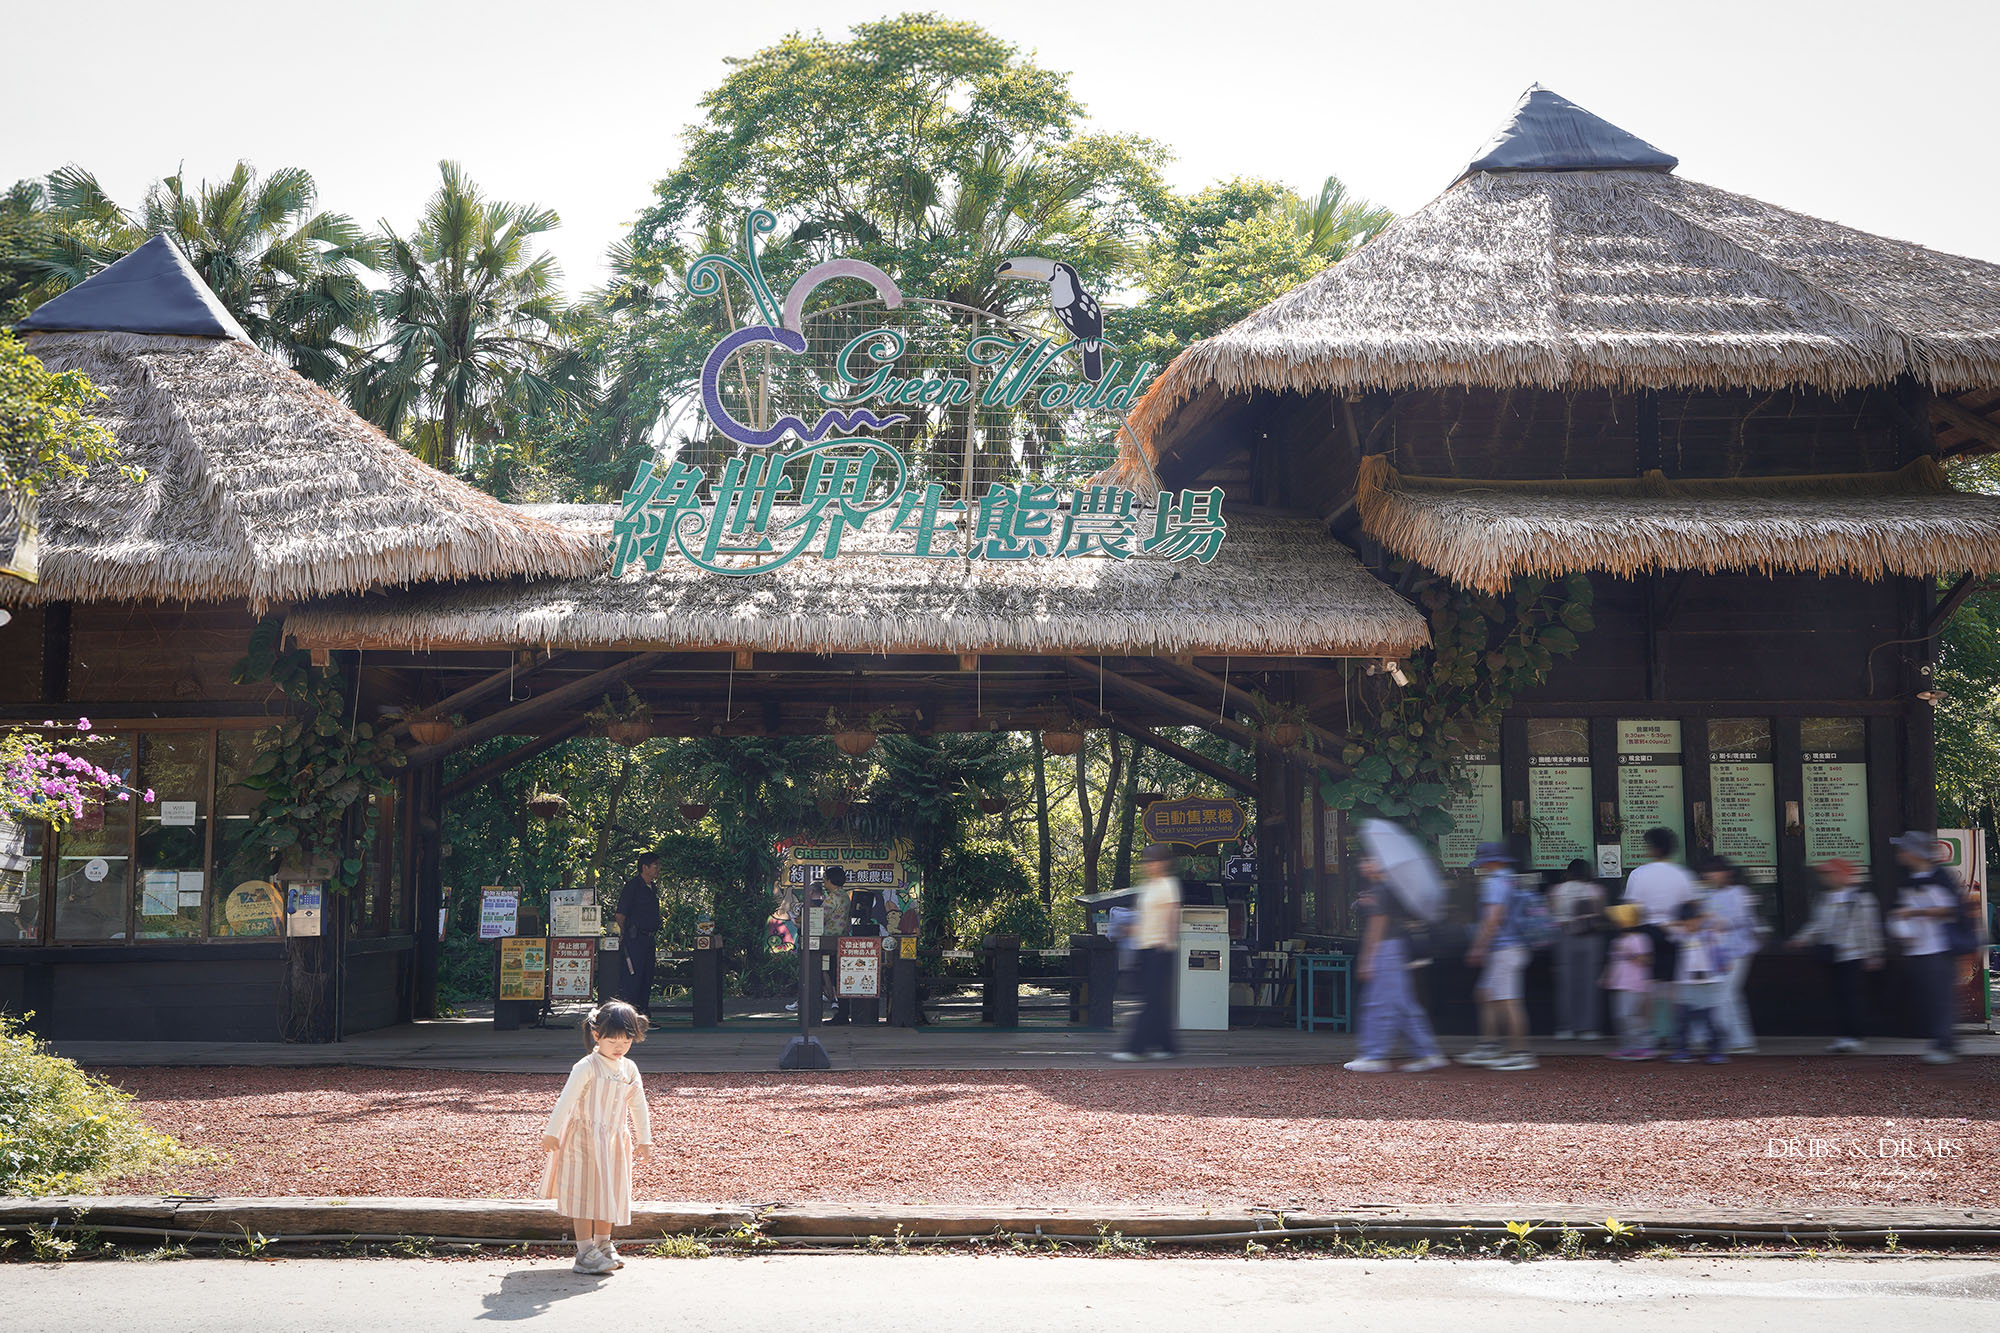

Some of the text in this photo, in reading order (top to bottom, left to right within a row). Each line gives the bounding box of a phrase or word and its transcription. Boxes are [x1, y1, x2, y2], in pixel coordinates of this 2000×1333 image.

[819, 328, 1152, 411] Green World
[608, 438, 1228, 578] 綠世界生態農場
[1155, 808, 1233, 826] 自動售票機
[794, 848, 889, 860] GREEN WORLD
[790, 864, 893, 883] 綠世生態農場
